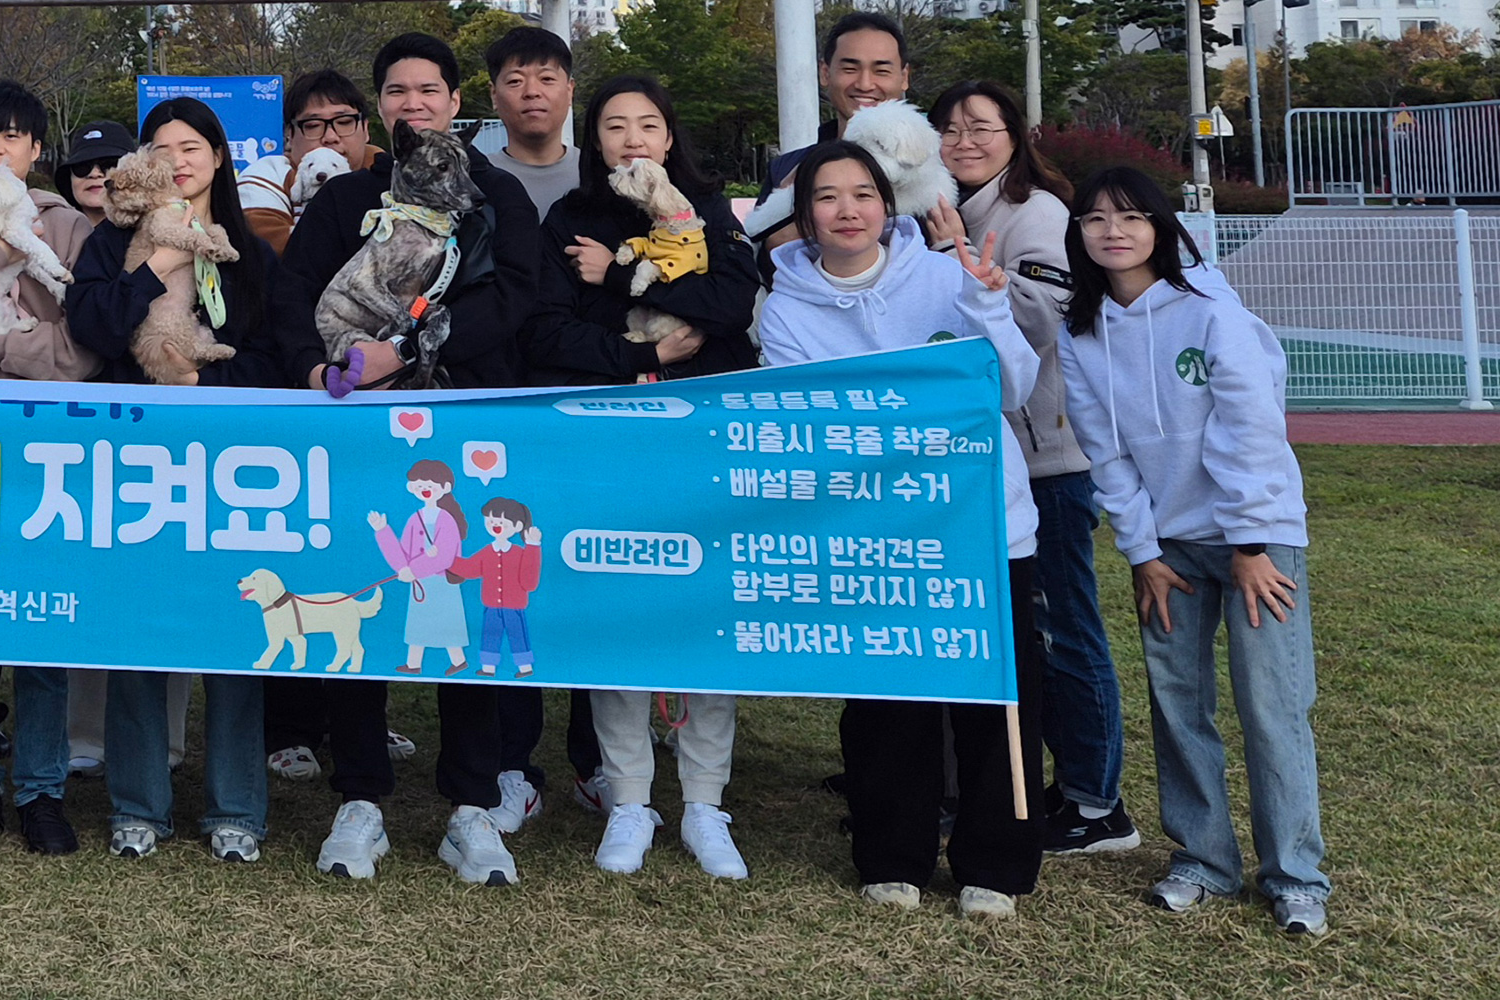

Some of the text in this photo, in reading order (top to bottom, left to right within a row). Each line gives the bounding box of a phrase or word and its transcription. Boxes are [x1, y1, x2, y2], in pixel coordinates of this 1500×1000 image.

[722, 388, 908, 410] 동물등록 필수
[727, 421, 814, 454] 외출시
[824, 425, 884, 456] 목줄
[20, 439, 332, 553] 지켜요!
[729, 468, 951, 503] 배설물 즉시 수거
[574, 536, 690, 569] 비반려인
[731, 532, 945, 570] 타인의 반려견은
[731, 570, 986, 609] 함부로 만지지 않기
[734, 621, 990, 660] 뚫어져라 보지 않기
